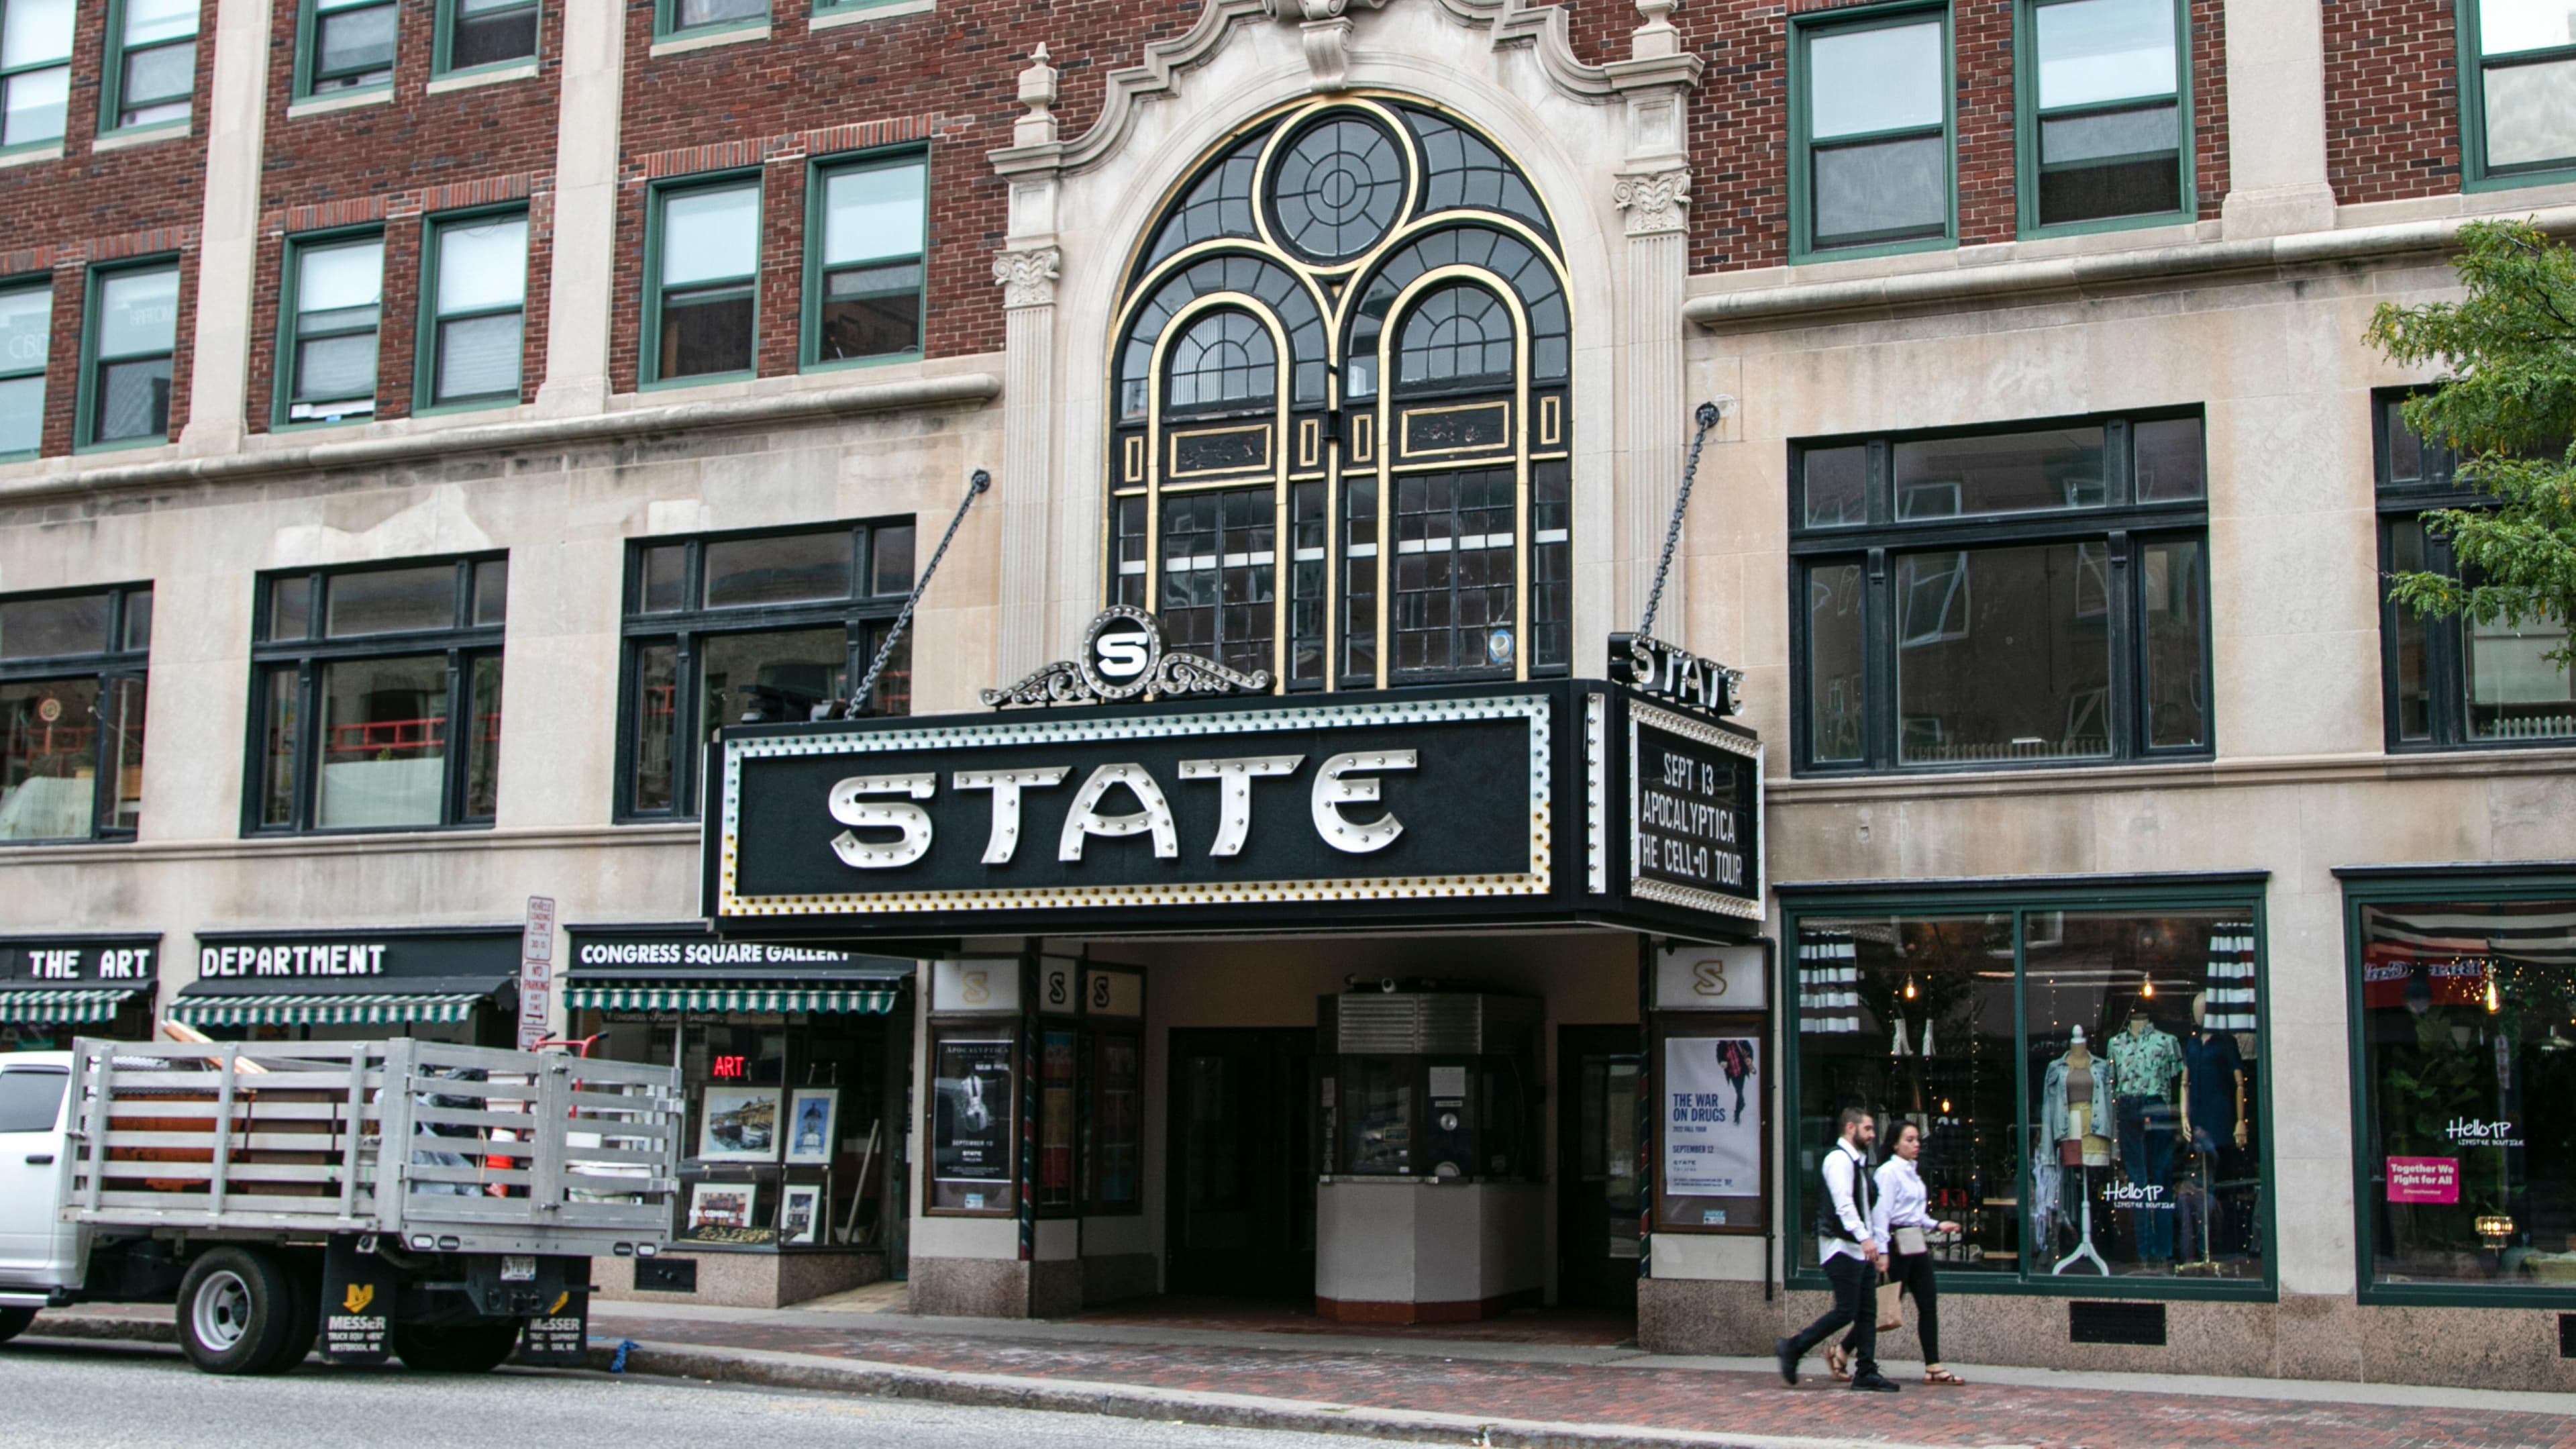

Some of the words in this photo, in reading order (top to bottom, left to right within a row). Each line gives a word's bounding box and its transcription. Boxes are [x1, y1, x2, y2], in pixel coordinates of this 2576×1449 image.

[1096, 632, 1149, 677] S
[1629, 632, 1745, 717] STATE
[1663, 752, 1694, 791] SEPT
[1701, 762, 1714, 796] 13
[829, 749, 1417, 868] STATE
[1642, 790, 1736, 844] APOCALYPTICA
[1664, 839, 1708, 879] CELL-O
[1715, 850, 1743, 887] TOUR
[530, 913, 551, 921] LOADING
[29, 950, 81, 979] THE
[99, 948, 150, 978] ART
[201, 945, 386, 977] DEPARTMENT
[580, 944, 681, 964] CONGRESS
[684, 944, 762, 965] SQUARE
[532, 966, 542, 977] NO
[1693, 959, 1727, 996] S
[525, 981, 549, 991] PARKING
[962, 971, 990, 1004] S
[1049, 972, 1066, 1004] S
[1093, 976, 1109, 1007] S
[713, 1056, 745, 1077] ART
[1673, 1093, 1692, 1107] THE
[1696, 1093, 1718, 1107] WAR
[1673, 1108, 1688, 1121] ON
[1691, 1108, 1726, 1122] DRUGS
[1673, 1145, 1706, 1153] SEPTEMBER
[1708, 1146, 1714, 1154] 12
[2391, 1164, 2436, 1175] Together
[2438, 1165, 2455, 1174] We
[2393, 1175, 2420, 1186] Fight
[2421, 1175, 2436, 1185] for
[2438, 1176, 2453, 1185] All
[329, 1315, 387, 1330] MESSER
[328, 1332, 348, 1341] TRUCK
